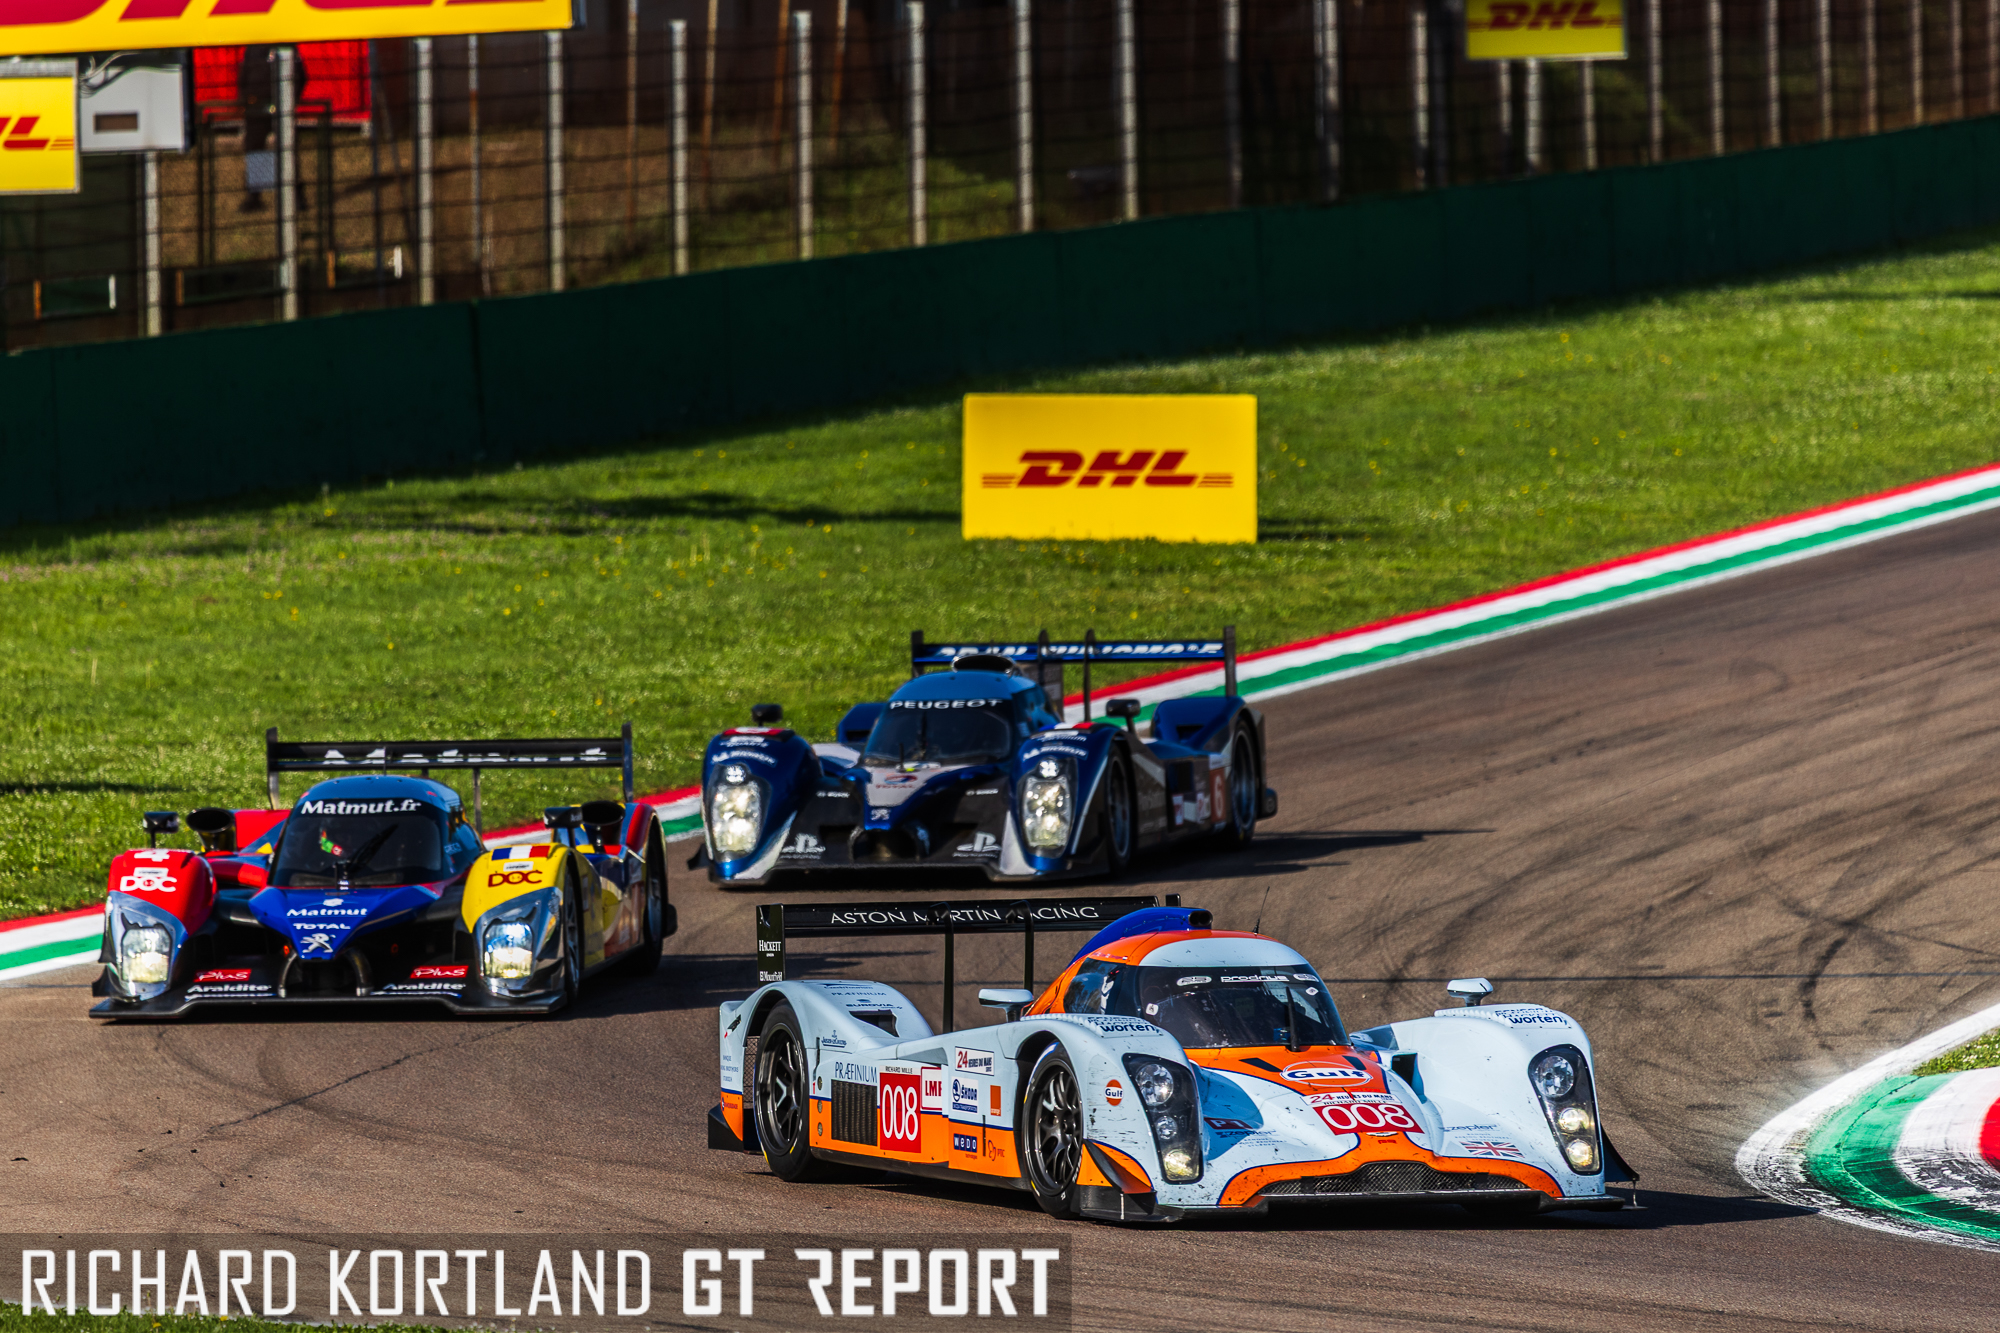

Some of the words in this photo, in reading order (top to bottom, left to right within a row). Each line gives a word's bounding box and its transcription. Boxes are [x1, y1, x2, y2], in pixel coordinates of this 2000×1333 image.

[1487, 1, 1606, 31] DHL
[1015, 449, 1200, 489] DHL
[890, 698, 1003, 710] PEUGEOT
[301, 798, 422, 815] Matmut.fr
[120, 873, 178, 892] DOC
[488, 869, 543, 888] DOC
[286, 906, 368, 917] Matmut
[831, 911, 908, 924] ASTON
[913, 909, 1002, 922] MRTIN
[292, 922, 351, 931] TOTAL
[956, 1050, 968, 1069] 24
[1287, 1069, 1365, 1079] Gulf
[1104, 1088, 1123, 1098] Gulf
[1310, 1094, 1335, 1104] 24
[881, 1084, 919, 1142] 008
[1321, 1103, 1415, 1130] 008
